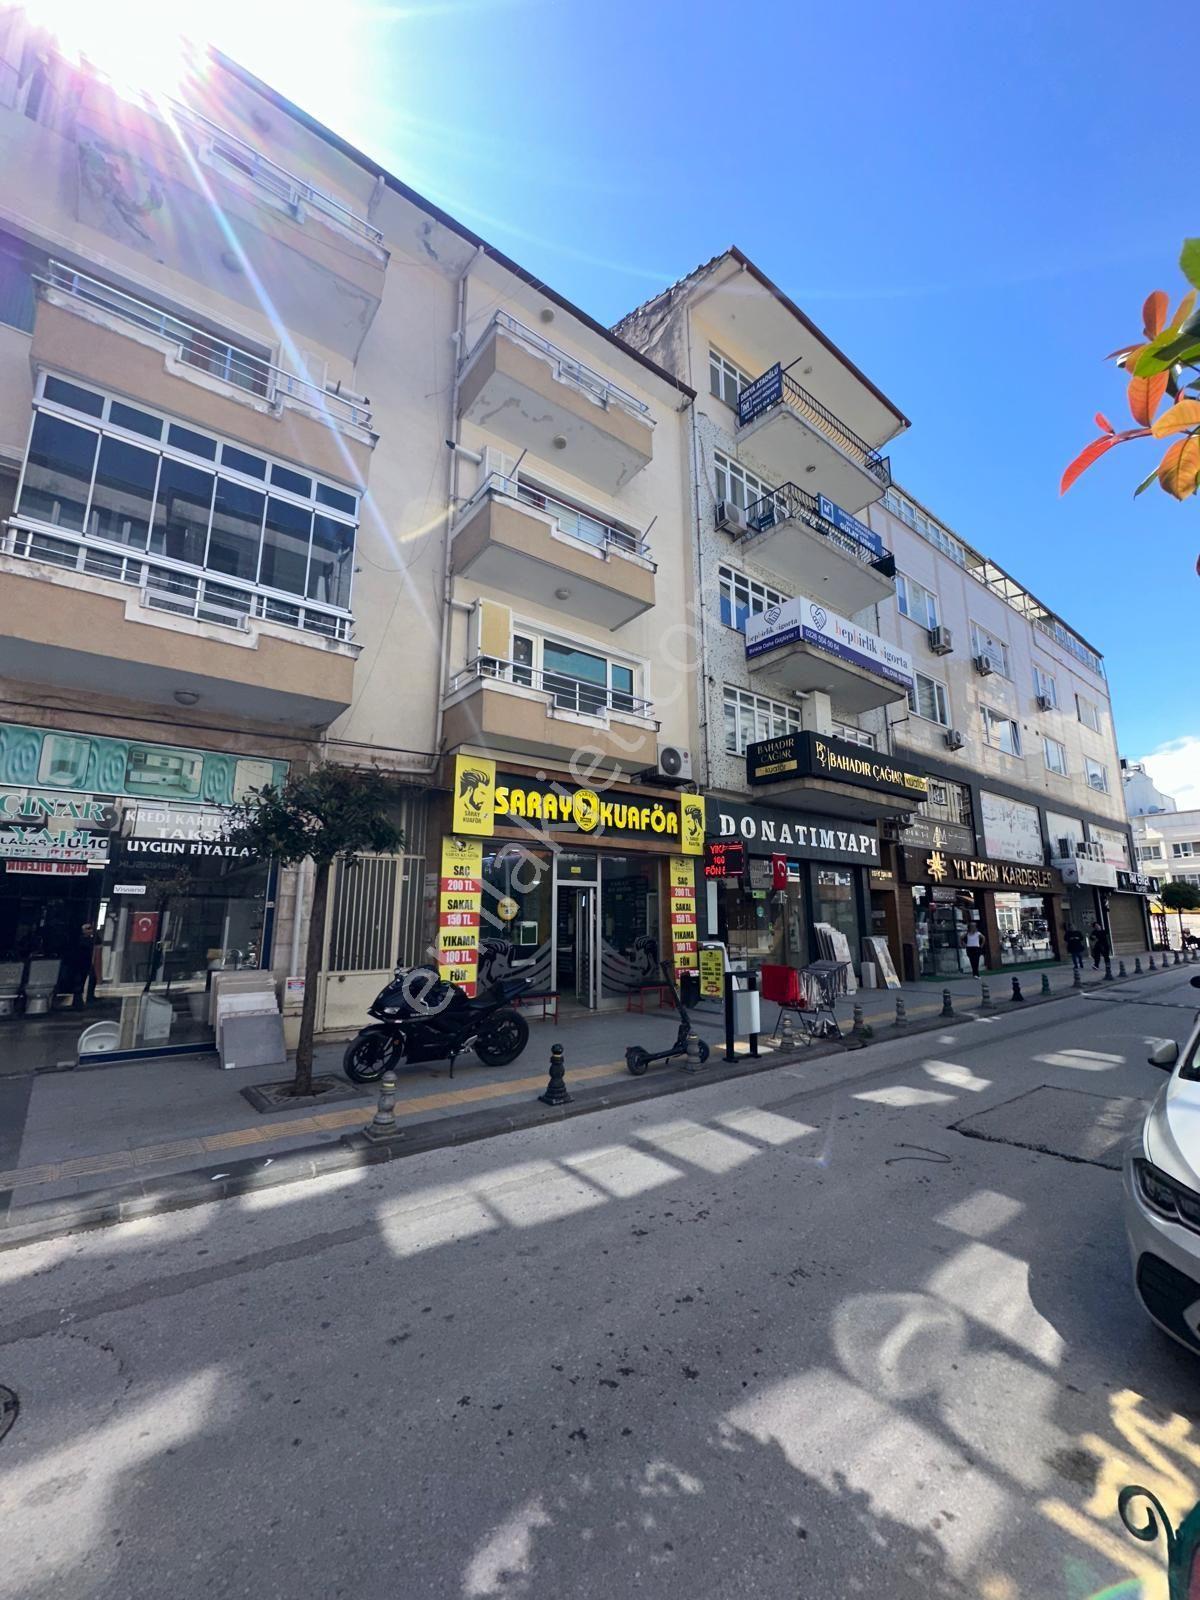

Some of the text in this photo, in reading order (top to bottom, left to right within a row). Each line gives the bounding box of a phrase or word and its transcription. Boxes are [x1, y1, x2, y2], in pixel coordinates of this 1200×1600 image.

[835, 619, 908, 670] hepbirlik sigorta
[757, 738, 795, 755] BAHADIR
[830, 752, 872, 777] BAHADIR
[872, 765, 904, 786] ÇAĞLAR
[0, 793, 105, 822] ÇINAR
[494, 786, 678, 834] SARAY KUAFÖR
[125, 809, 170, 824] KREDİ
[9, 825, 92, 846] YAPI
[126, 840, 185, 855] UYGUN
[453, 865, 471, 878] SAÇ
[953, 858, 1054, 890] YILDIRIM KARDEŞLER
[447, 880, 463, 891] 200
[447, 899, 473, 910] SAKAL
[675, 902, 692, 912] SAKAL
[446, 914, 461, 925] 150
[443, 936, 476, 947] YIKAMA
[673, 931, 694, 940] YIKAMA
[446, 951, 461, 962] 100
[450, 969, 467, 981] FÖN
